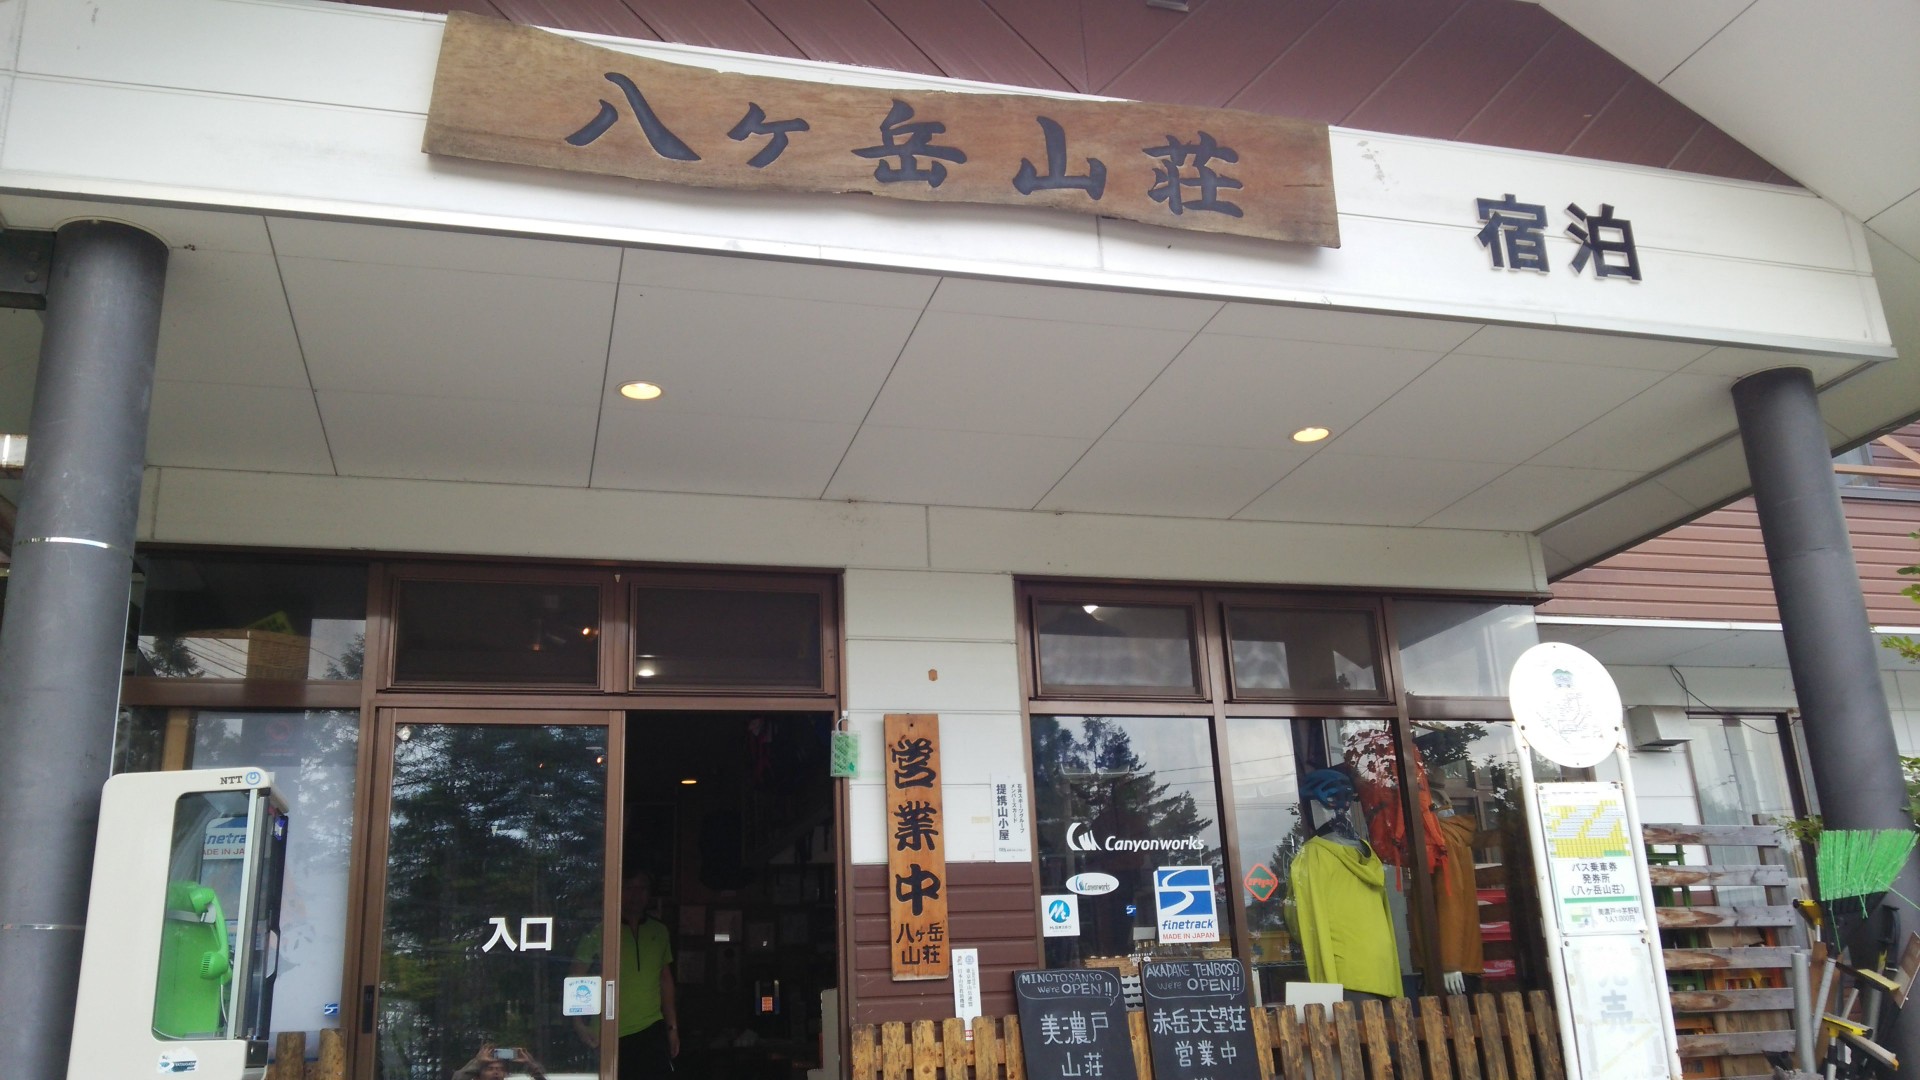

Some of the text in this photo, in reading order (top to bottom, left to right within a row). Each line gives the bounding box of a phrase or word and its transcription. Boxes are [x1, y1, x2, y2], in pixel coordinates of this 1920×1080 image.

[1474, 193, 1642, 283] 宿泊
[220, 775, 243, 785] NTT
[996, 783, 1010, 841] 提携山小屋
[891, 737, 941, 916] 営業中
[221, 848, 231, 856] IN
[1104, 835, 1205, 852] Canyonworks
[1571, 861, 1618, 872] バス乗車券
[1084, 882, 1111, 892] Canyonworks
[1582, 873, 1610, 884] 発券所
[481, 916, 553, 953] 入口
[1161, 918, 1213, 930] finetrack
[901, 944, 941, 965] 山荘
[1146, 961, 1240, 978] AKADAKE TENBOSO
[1040, 1010, 1109, 1045] 美濃戸
[1152, 1004, 1247, 1036] 赤岳天望荘
[1174, 1039, 1237, 1067] 営業中
[1061, 1051, 1104, 1077] 山荘
